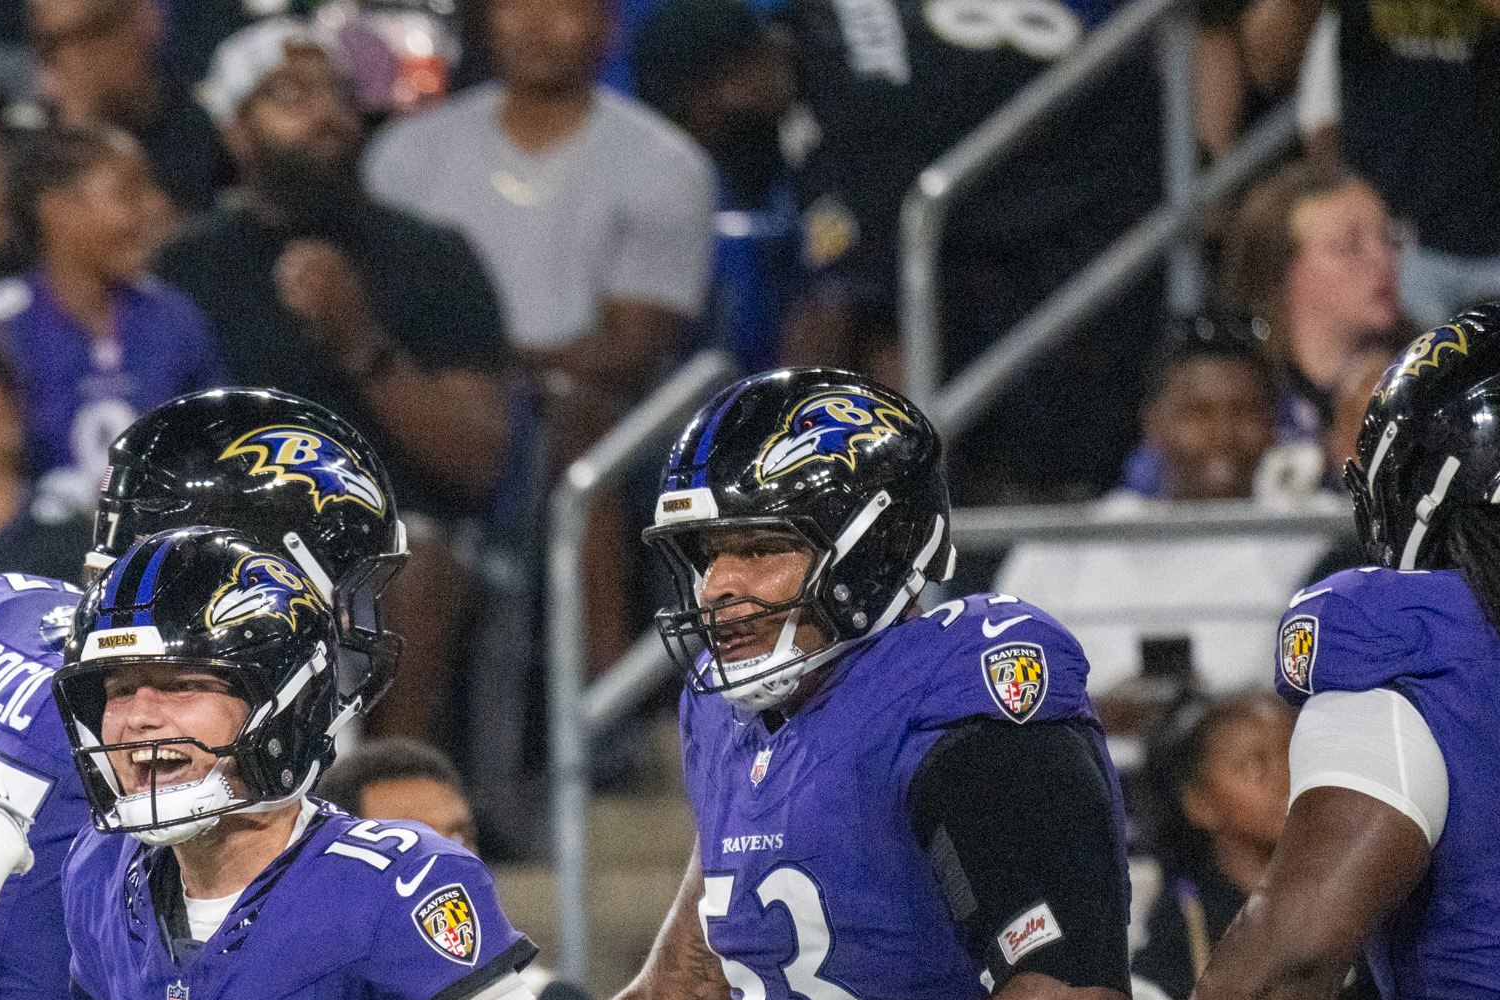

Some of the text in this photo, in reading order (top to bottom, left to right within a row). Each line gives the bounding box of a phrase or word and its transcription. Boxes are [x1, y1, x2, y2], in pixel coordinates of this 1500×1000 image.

[267, 432, 322, 465] B
[97, 633, 137, 650] RAVENS
[988, 649, 1037, 664] RAVENS
[324, 820, 419, 871] 15
[721, 833, 784, 854] RAVENS
[418, 889, 461, 920] RAVENS
